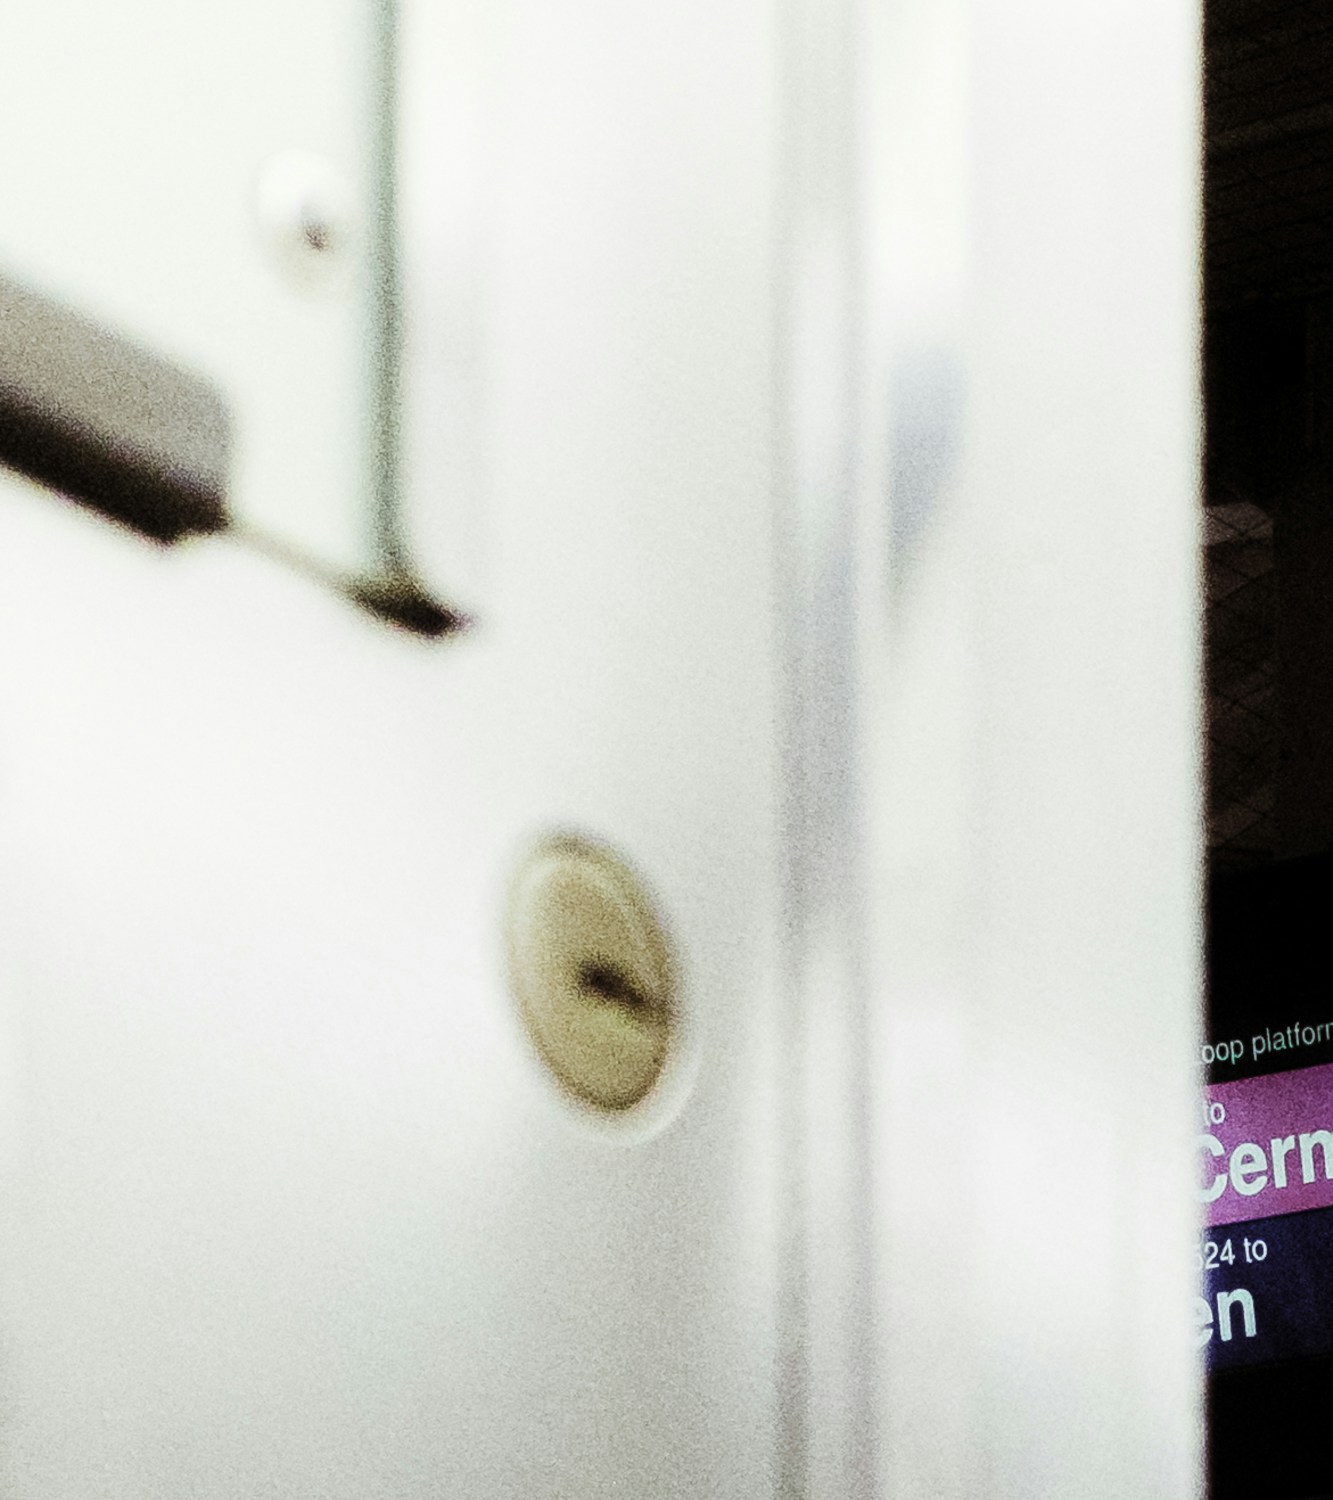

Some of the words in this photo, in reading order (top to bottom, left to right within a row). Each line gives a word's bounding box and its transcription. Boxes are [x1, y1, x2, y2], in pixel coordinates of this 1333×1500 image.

[1200, 1038, 1244, 1065] oop
[1200, 1238, 1236, 1270] 24
[1243, 1237, 1268, 1263] to
[1197, 1288, 1257, 1348] en
